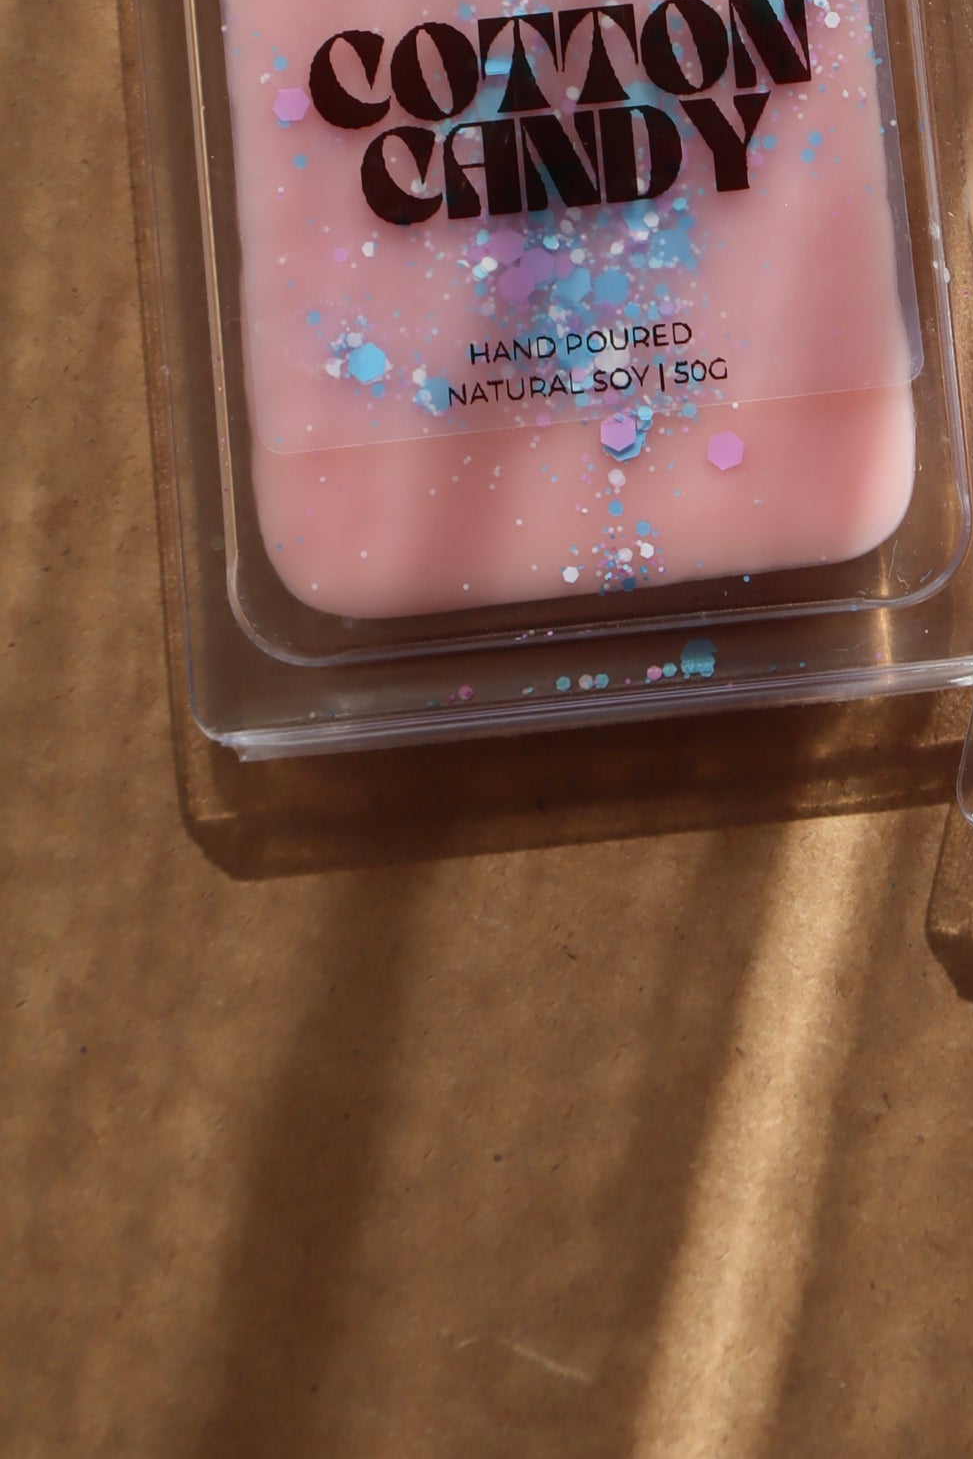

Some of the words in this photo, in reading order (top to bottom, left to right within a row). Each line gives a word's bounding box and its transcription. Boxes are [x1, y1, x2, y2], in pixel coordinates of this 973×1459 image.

[360, 91, 771, 226] CANDY
[469, 336, 556, 365] HAND
[566, 322, 692, 355] POURED
[448, 373, 584, 406] NATURAL
[592, 364, 649, 392] SOY
[673, 357, 728, 384] 50G
